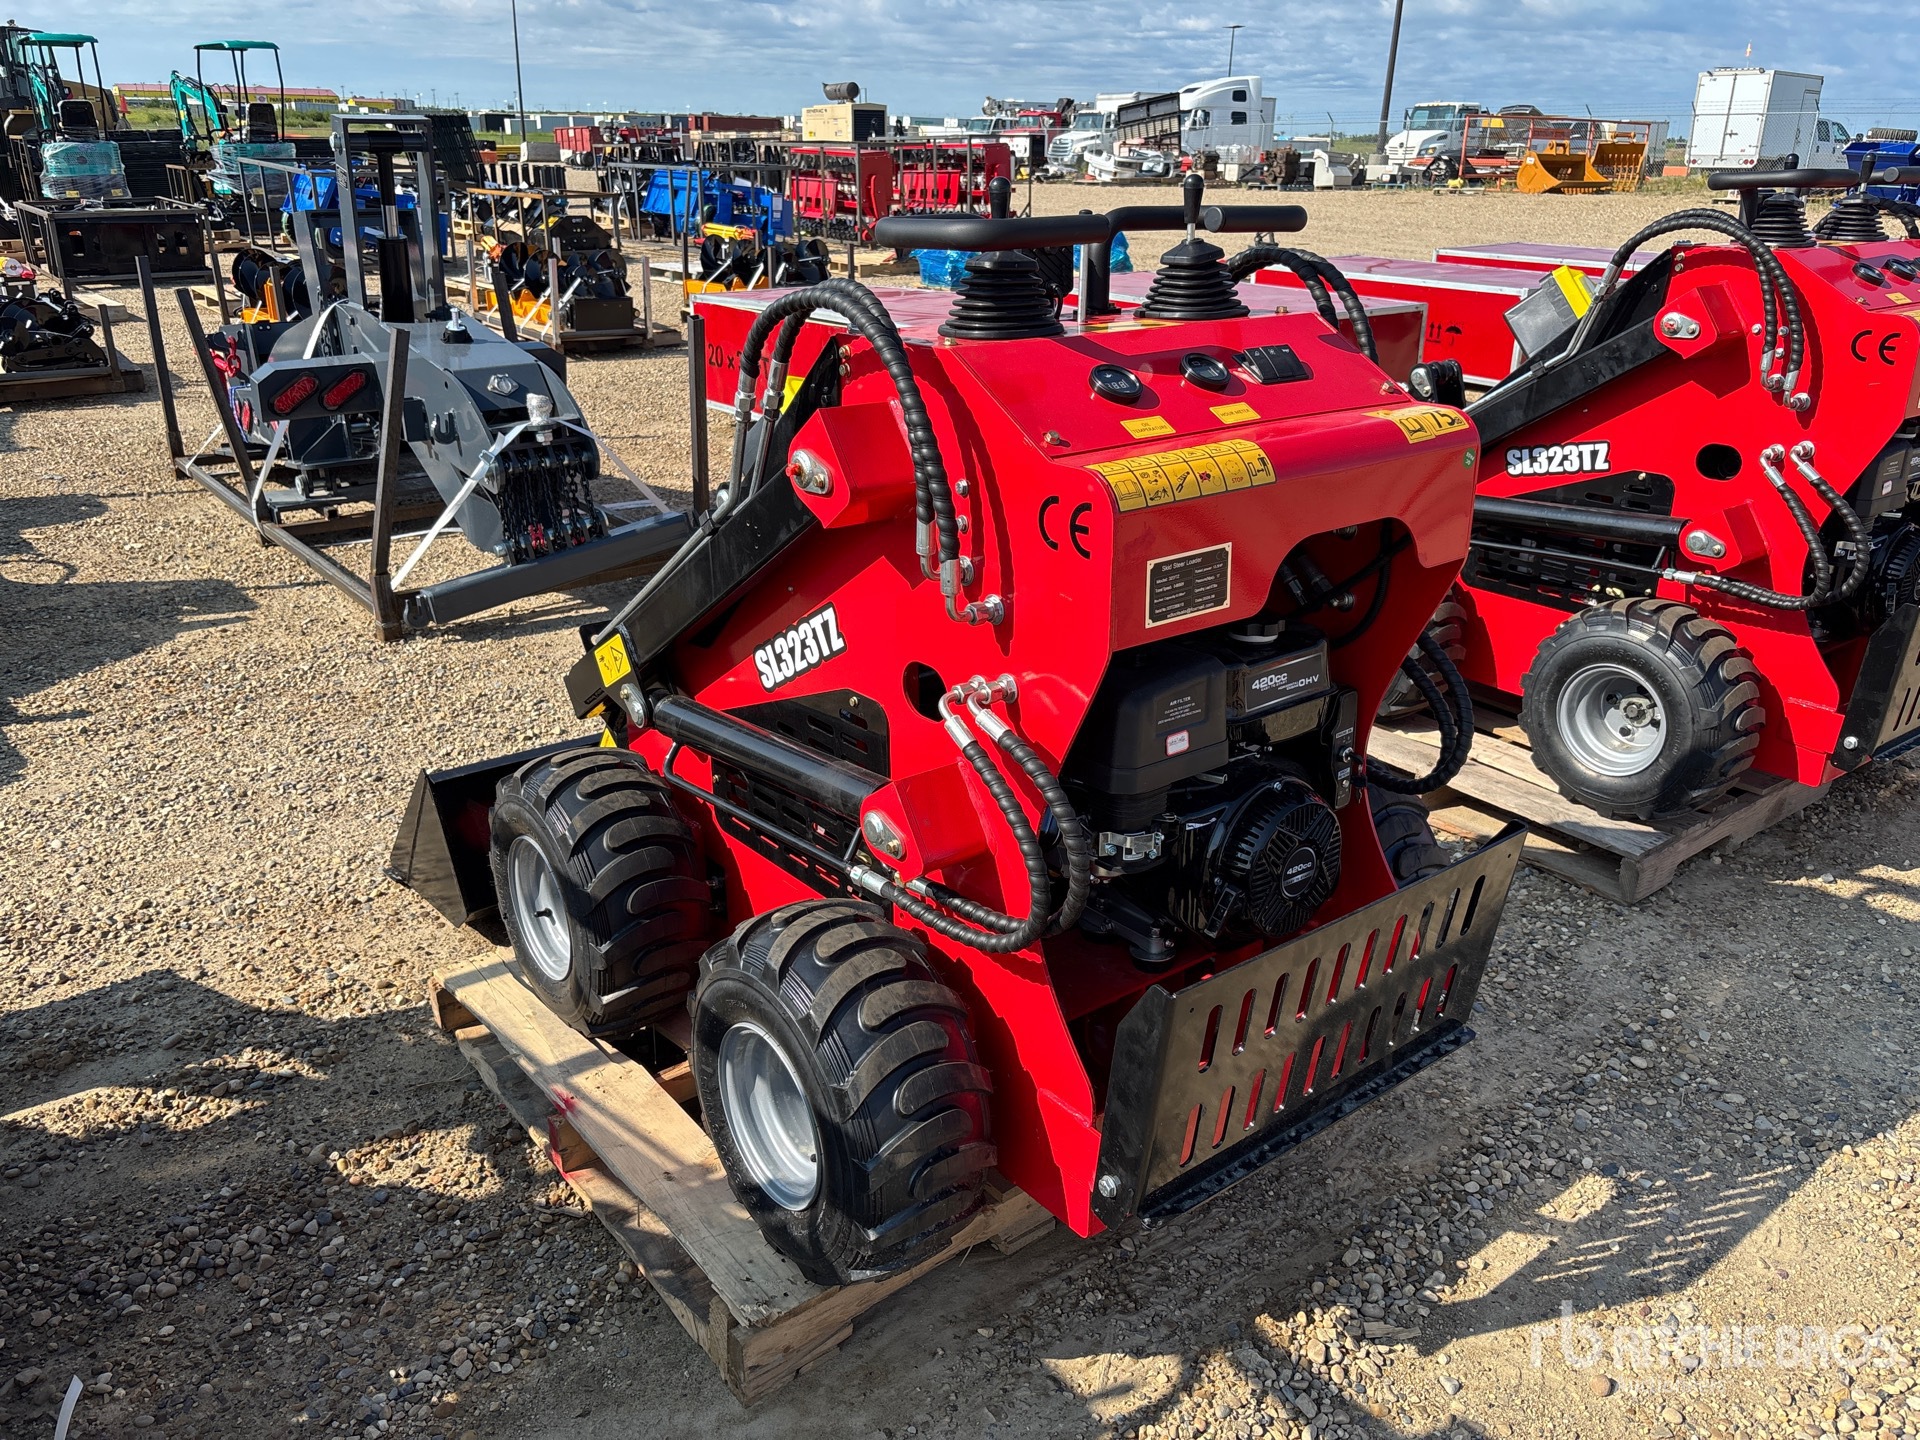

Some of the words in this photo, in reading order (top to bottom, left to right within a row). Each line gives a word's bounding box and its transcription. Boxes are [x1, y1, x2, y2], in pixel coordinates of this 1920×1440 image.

[708, 343, 724, 368] 20
[1422, 410, 1456, 429] 75
[1132, 424, 1168, 434] TEMPERATURE
[1506, 443, 1609, 475] SL323TZ
[1161, 563, 1173, 572] Skid
[1173, 561, 1186, 569] Steer
[1186, 557, 1203, 566] Loader
[754, 606, 845, 689] SL323TZ
[1251, 672, 1288, 690] 420cc
[1298, 674, 1319, 687] OHV
[1177, 696, 1191, 704] FILTER
[1286, 861, 1312, 875] 420cc
